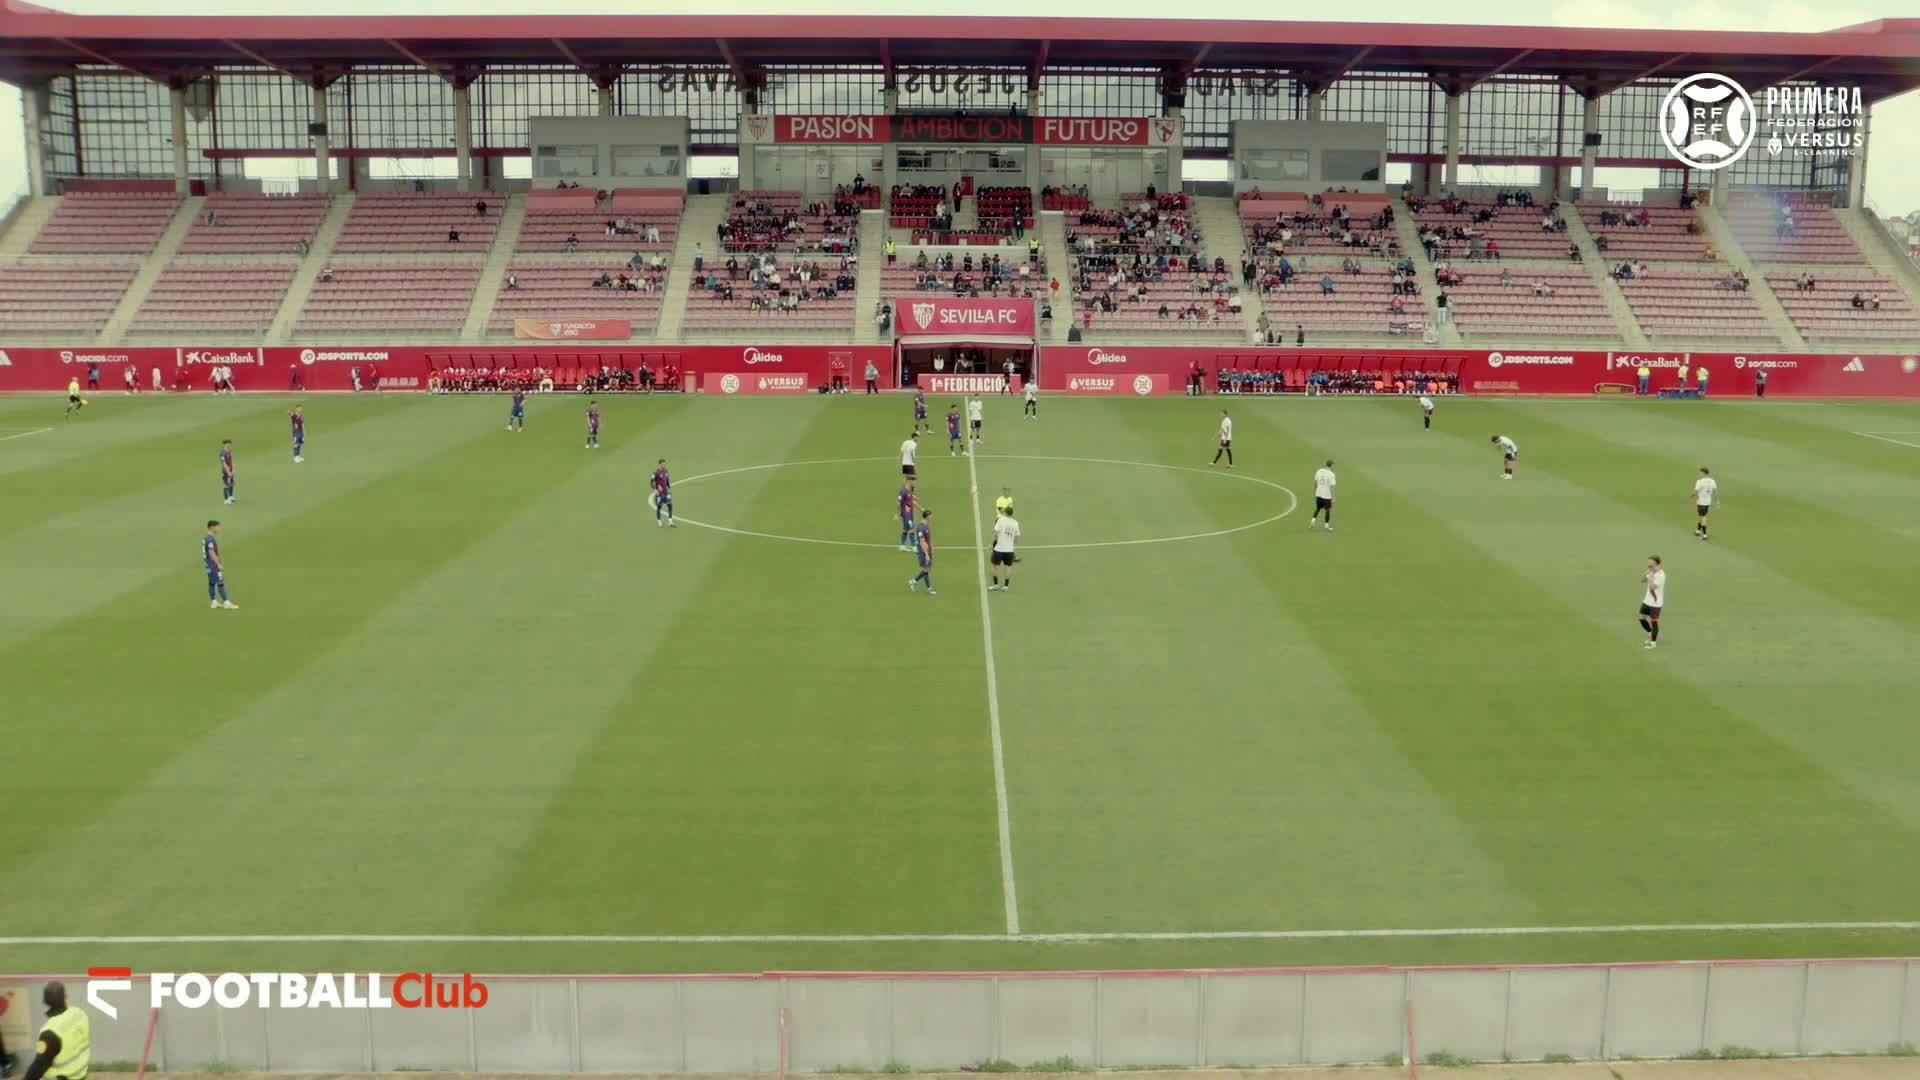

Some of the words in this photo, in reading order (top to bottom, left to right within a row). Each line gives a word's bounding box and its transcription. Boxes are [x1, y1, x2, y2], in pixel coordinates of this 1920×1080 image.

[791, 114, 873, 139] PASIÓN
[1045, 119, 1138, 141] FUTURO
[940, 308, 995, 323] SEVILLA
[998, 309, 1016, 323] FC
[202, 352, 255, 364] CaixaBank
[316, 352, 388, 361] JDSPORTS.COM
[748, 350, 783, 363] Midea
[1503, 355, 1573, 365] JDSPORTS.COM
[767, 377, 804, 386] VERSUS
[1078, 378, 1114, 386] VERSUS
